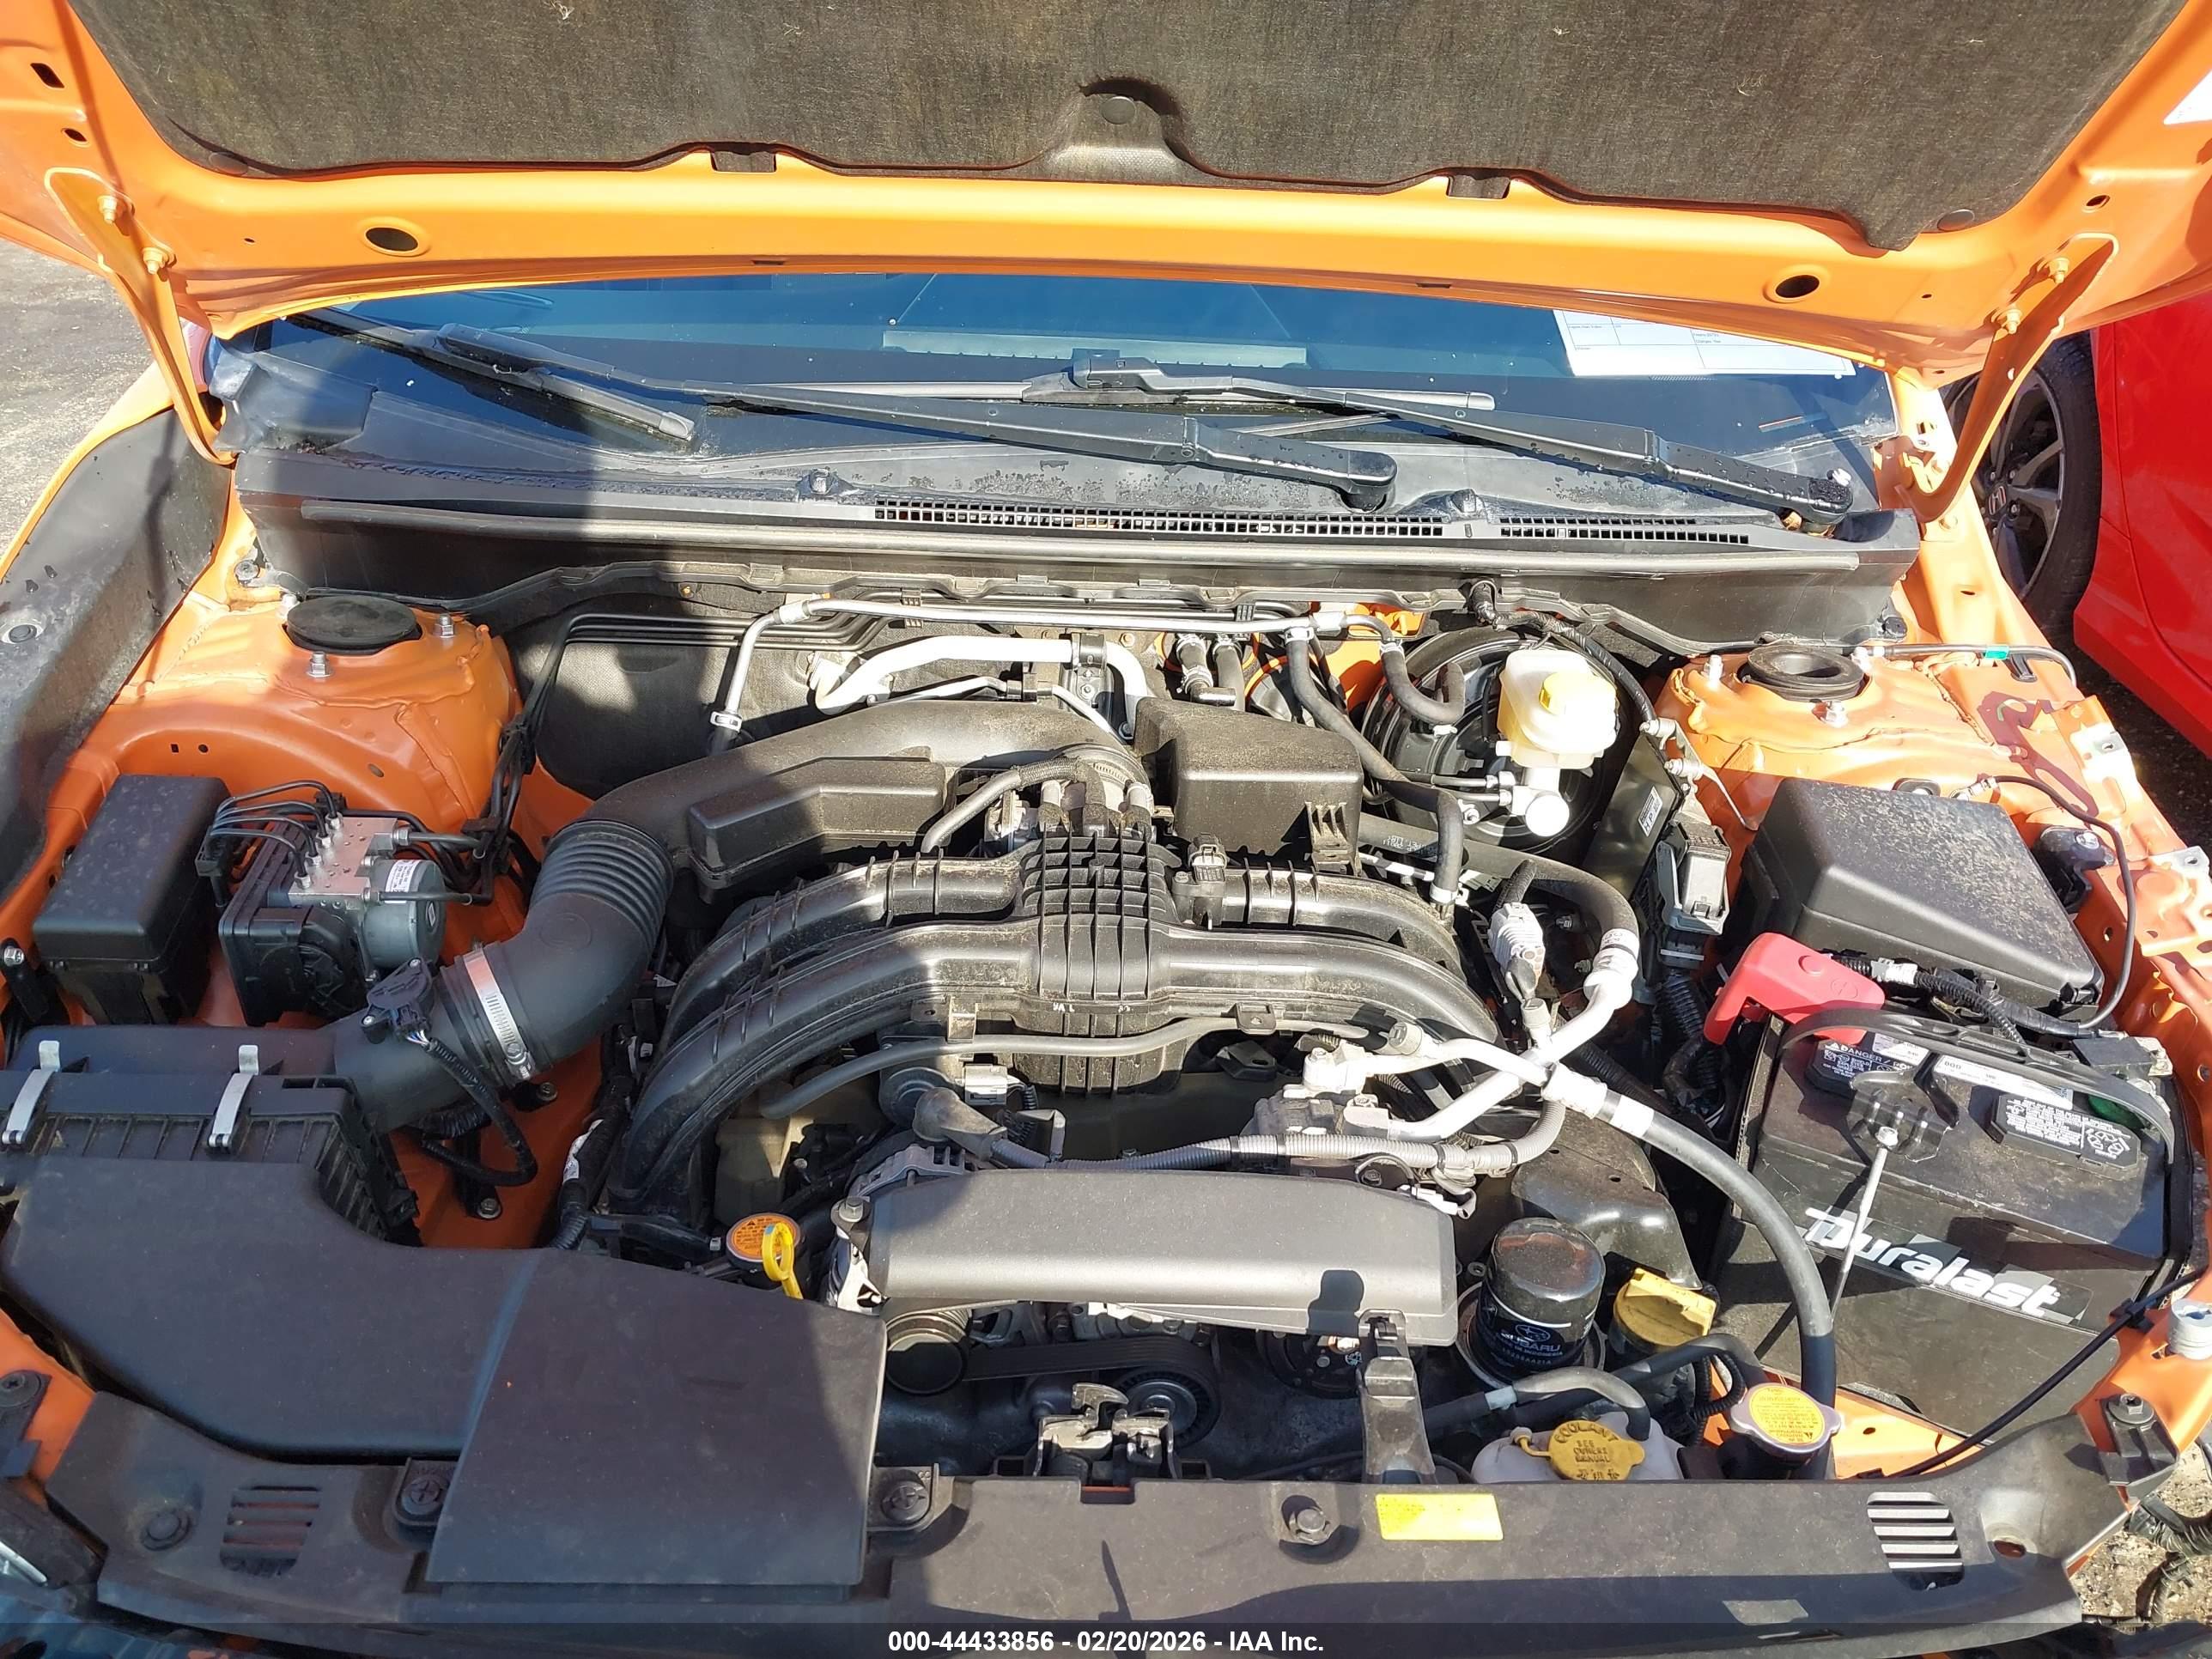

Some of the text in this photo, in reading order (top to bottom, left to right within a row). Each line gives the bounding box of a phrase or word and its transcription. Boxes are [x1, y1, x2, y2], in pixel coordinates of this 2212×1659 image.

[1840, 1043, 1883, 1062] DANGER
[1805, 1207, 2059, 1317] Duralast
[1498, 1330, 1561, 1352] SUBARU
[1554, 1422, 1619, 1443] COOLANT
